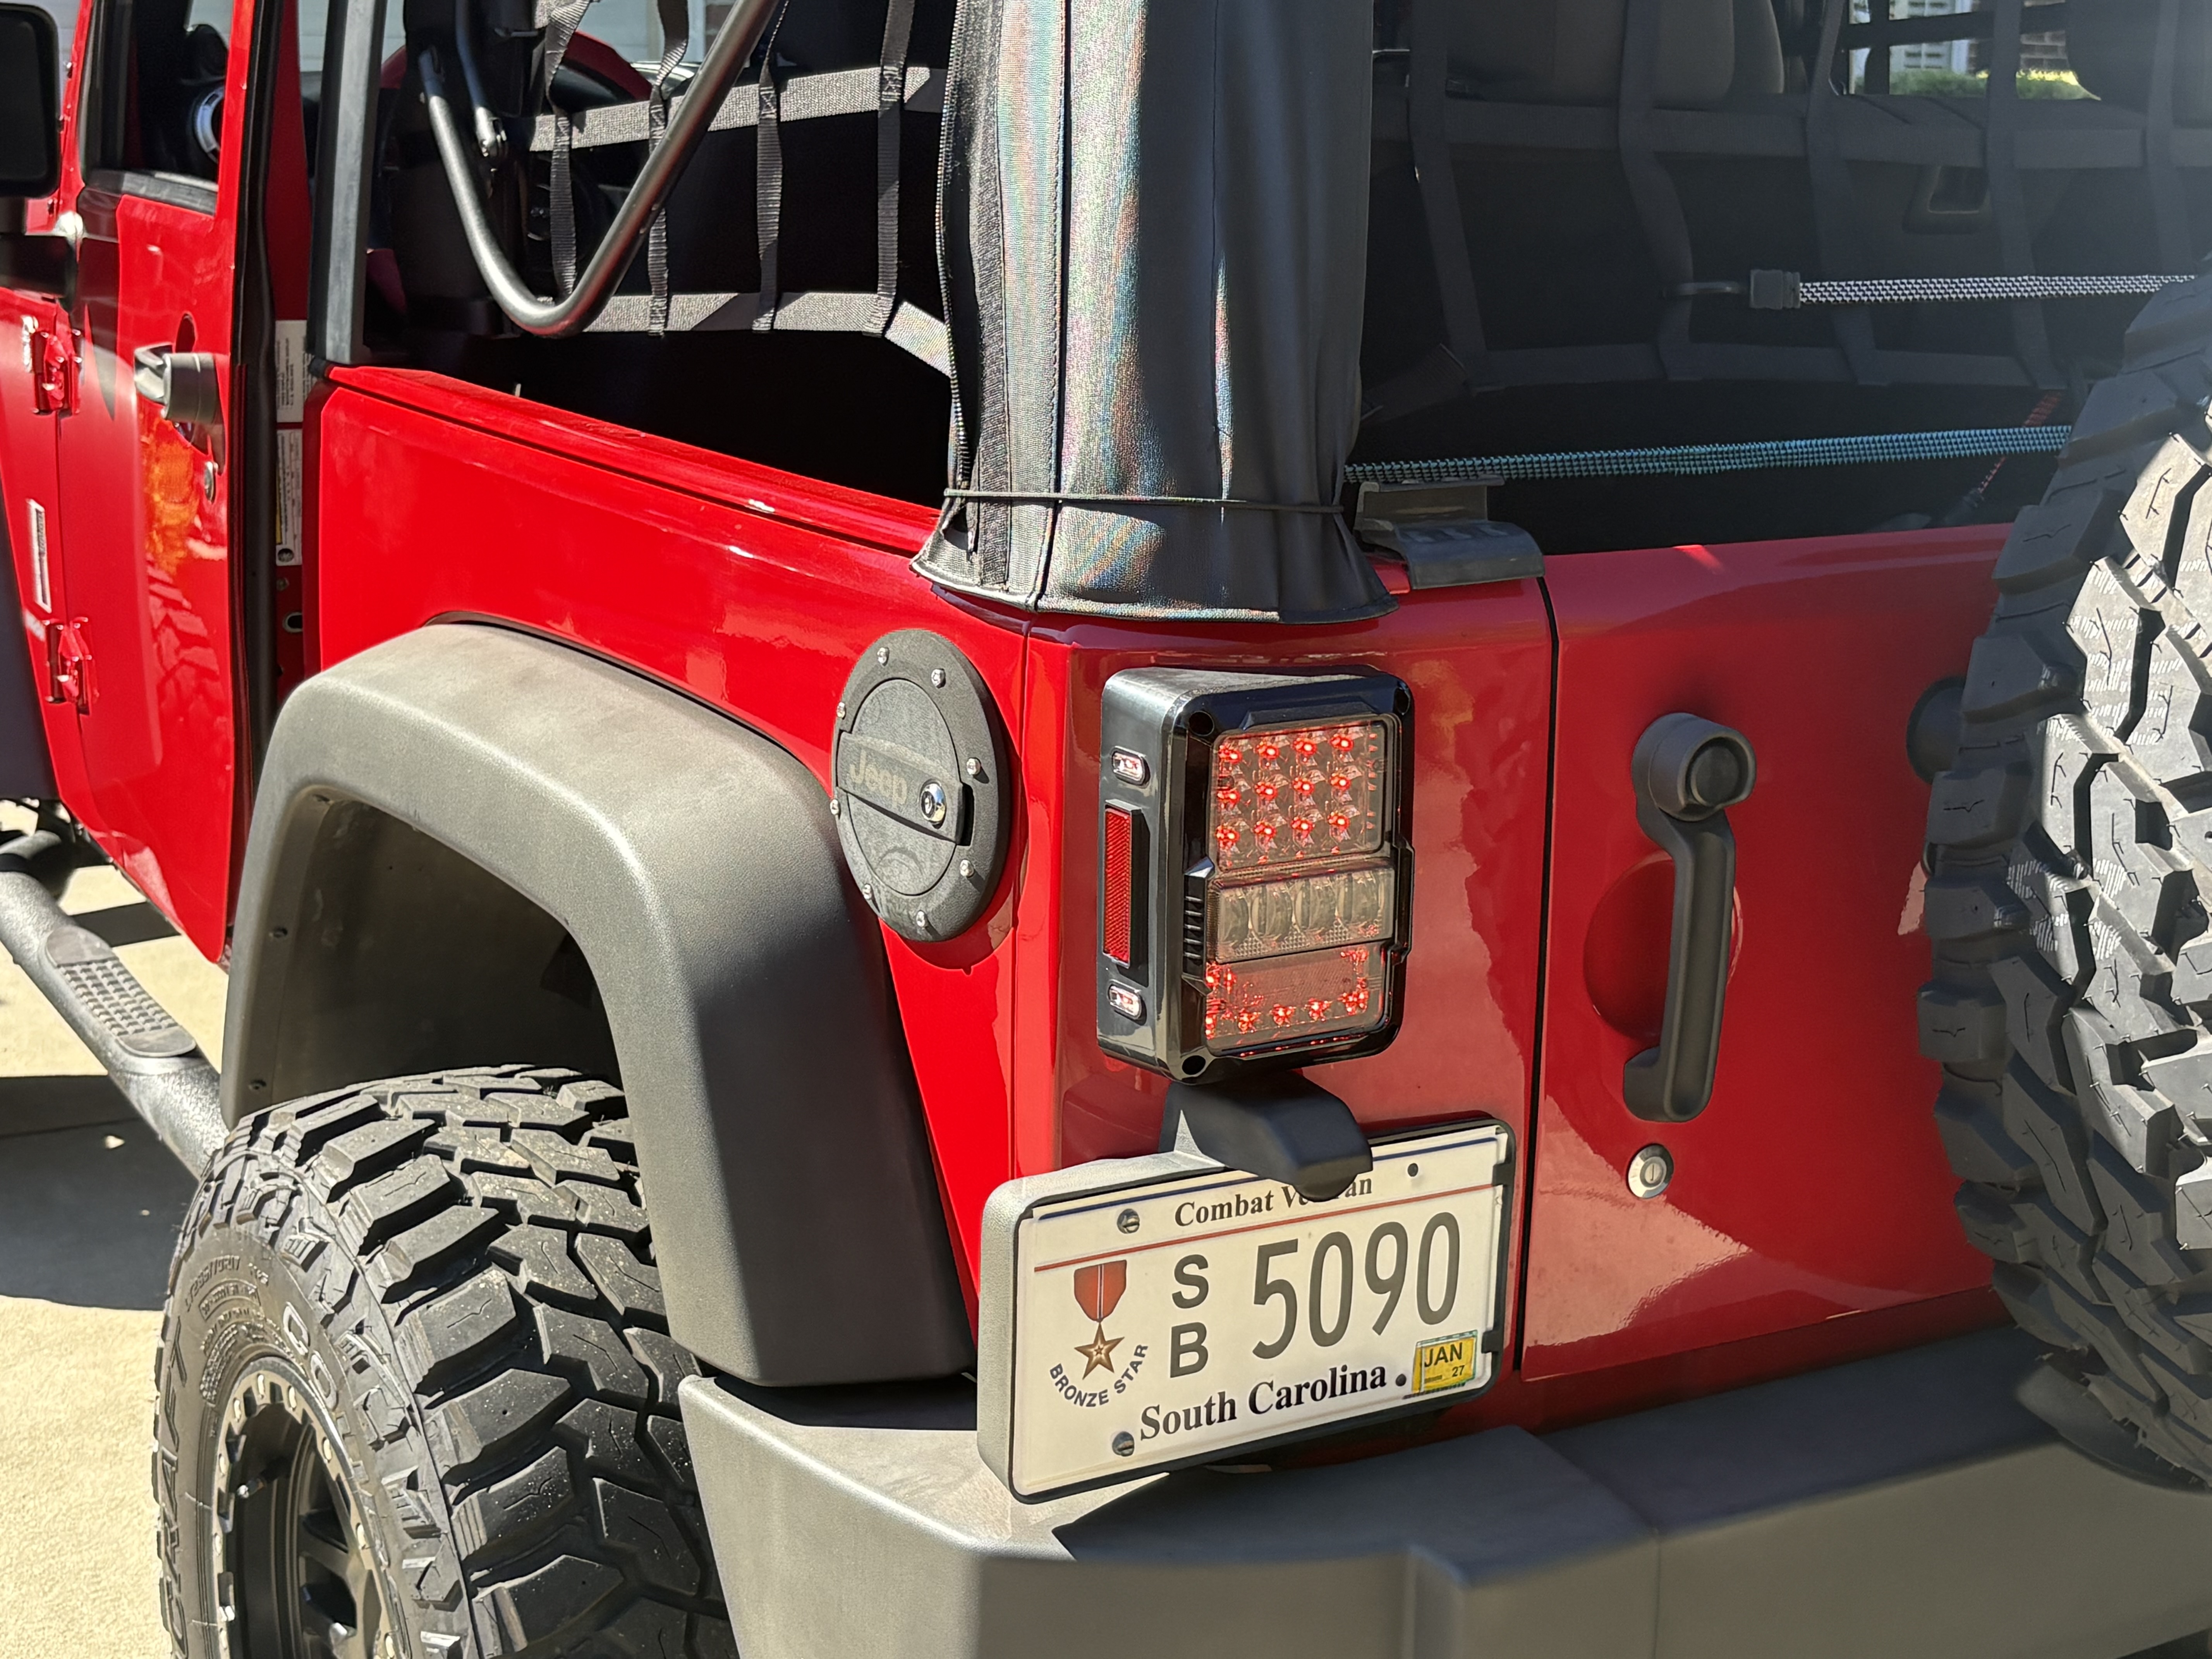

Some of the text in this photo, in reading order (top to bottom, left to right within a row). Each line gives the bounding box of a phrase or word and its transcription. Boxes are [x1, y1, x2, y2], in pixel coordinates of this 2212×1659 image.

[849, 749, 907, 808] Jeep
[1175, 1190, 1274, 1227] Combat
[1172, 1254, 1209, 1309] S
[1252, 1212, 1460, 1359] 5090
[1049, 1344, 1149, 1407] BRONZE STAR
[1170, 1322, 1208, 1378] B
[1424, 1342, 1463, 1367] JAN
[1452, 1365, 1465, 1377] 27
[1140, 1364, 1387, 1441] South Carolina
